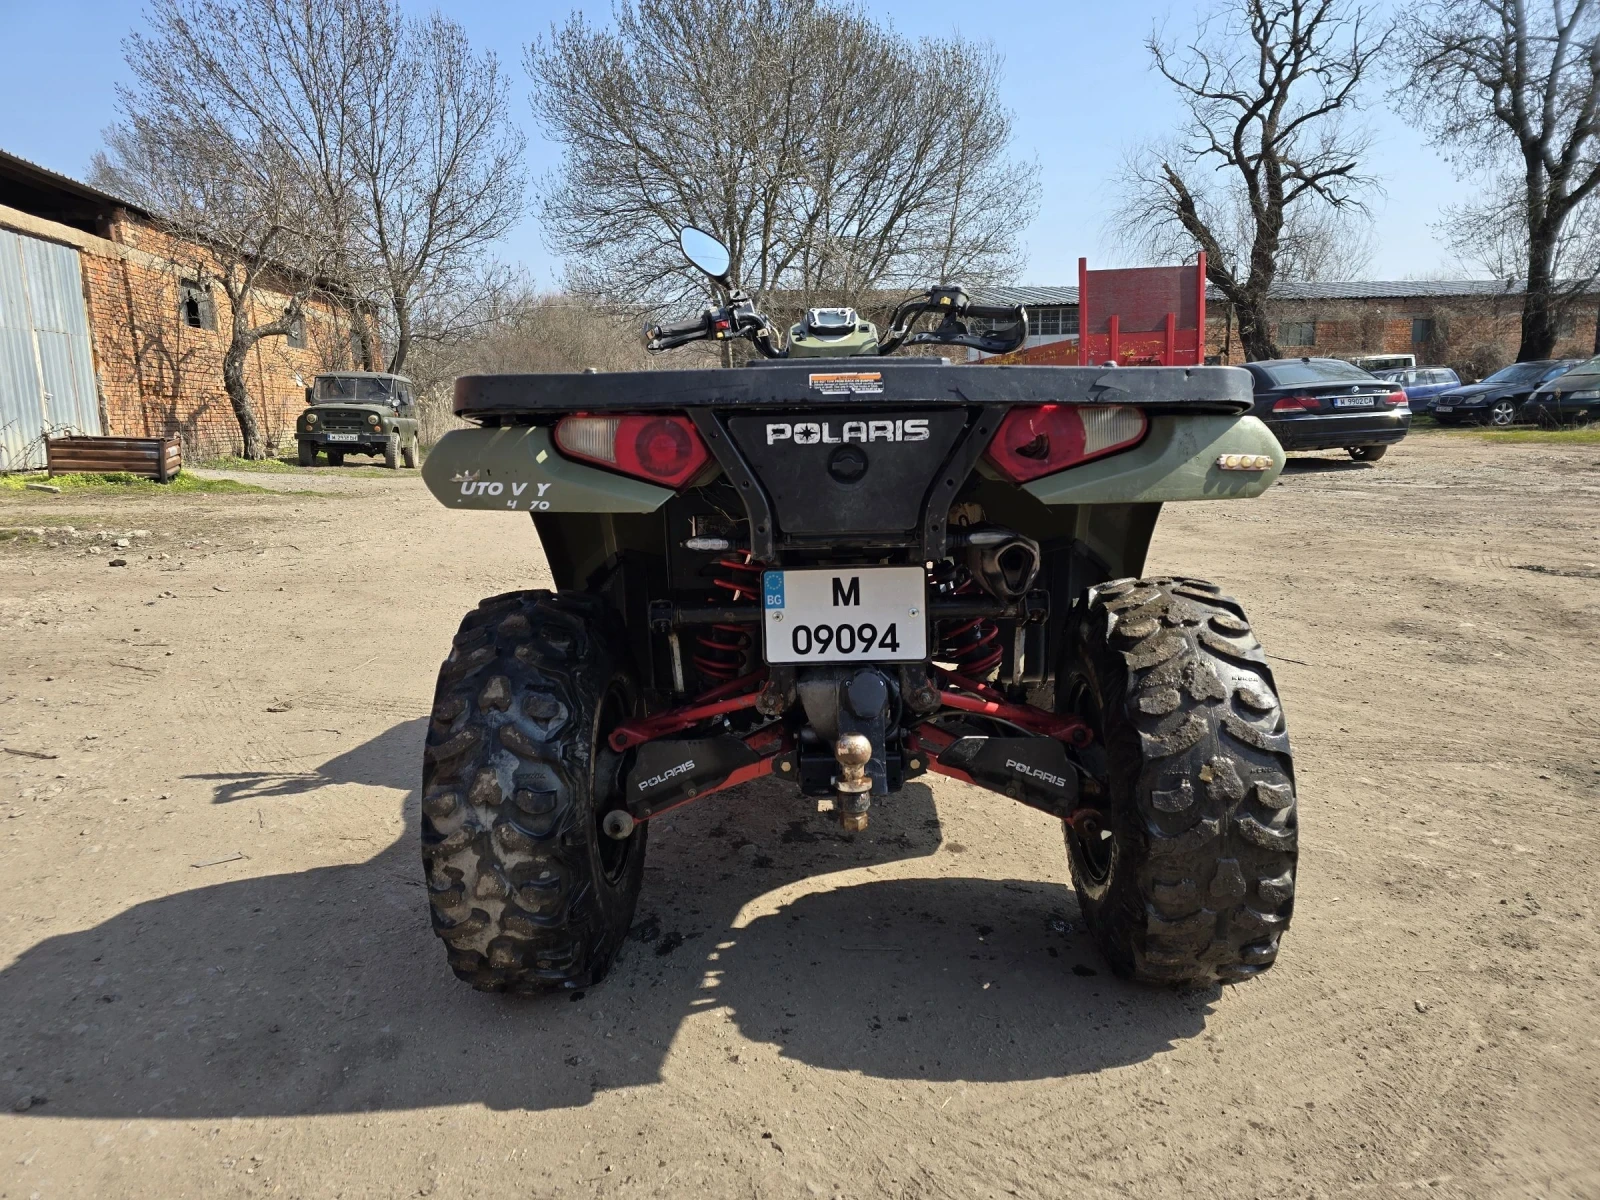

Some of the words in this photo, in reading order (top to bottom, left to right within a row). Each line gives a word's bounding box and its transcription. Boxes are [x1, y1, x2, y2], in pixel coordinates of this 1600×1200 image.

[1347, 397, 1373, 406] 9902CA
[766, 419, 930, 445] POLARIS
[529, 501, 550, 510] 70
[767, 594, 782, 605] BG
[832, 577, 861, 606] M
[792, 622, 900, 655] 09094
[638, 759, 696, 791] POLARIS
[1005, 759, 1067, 787] POLARIS
